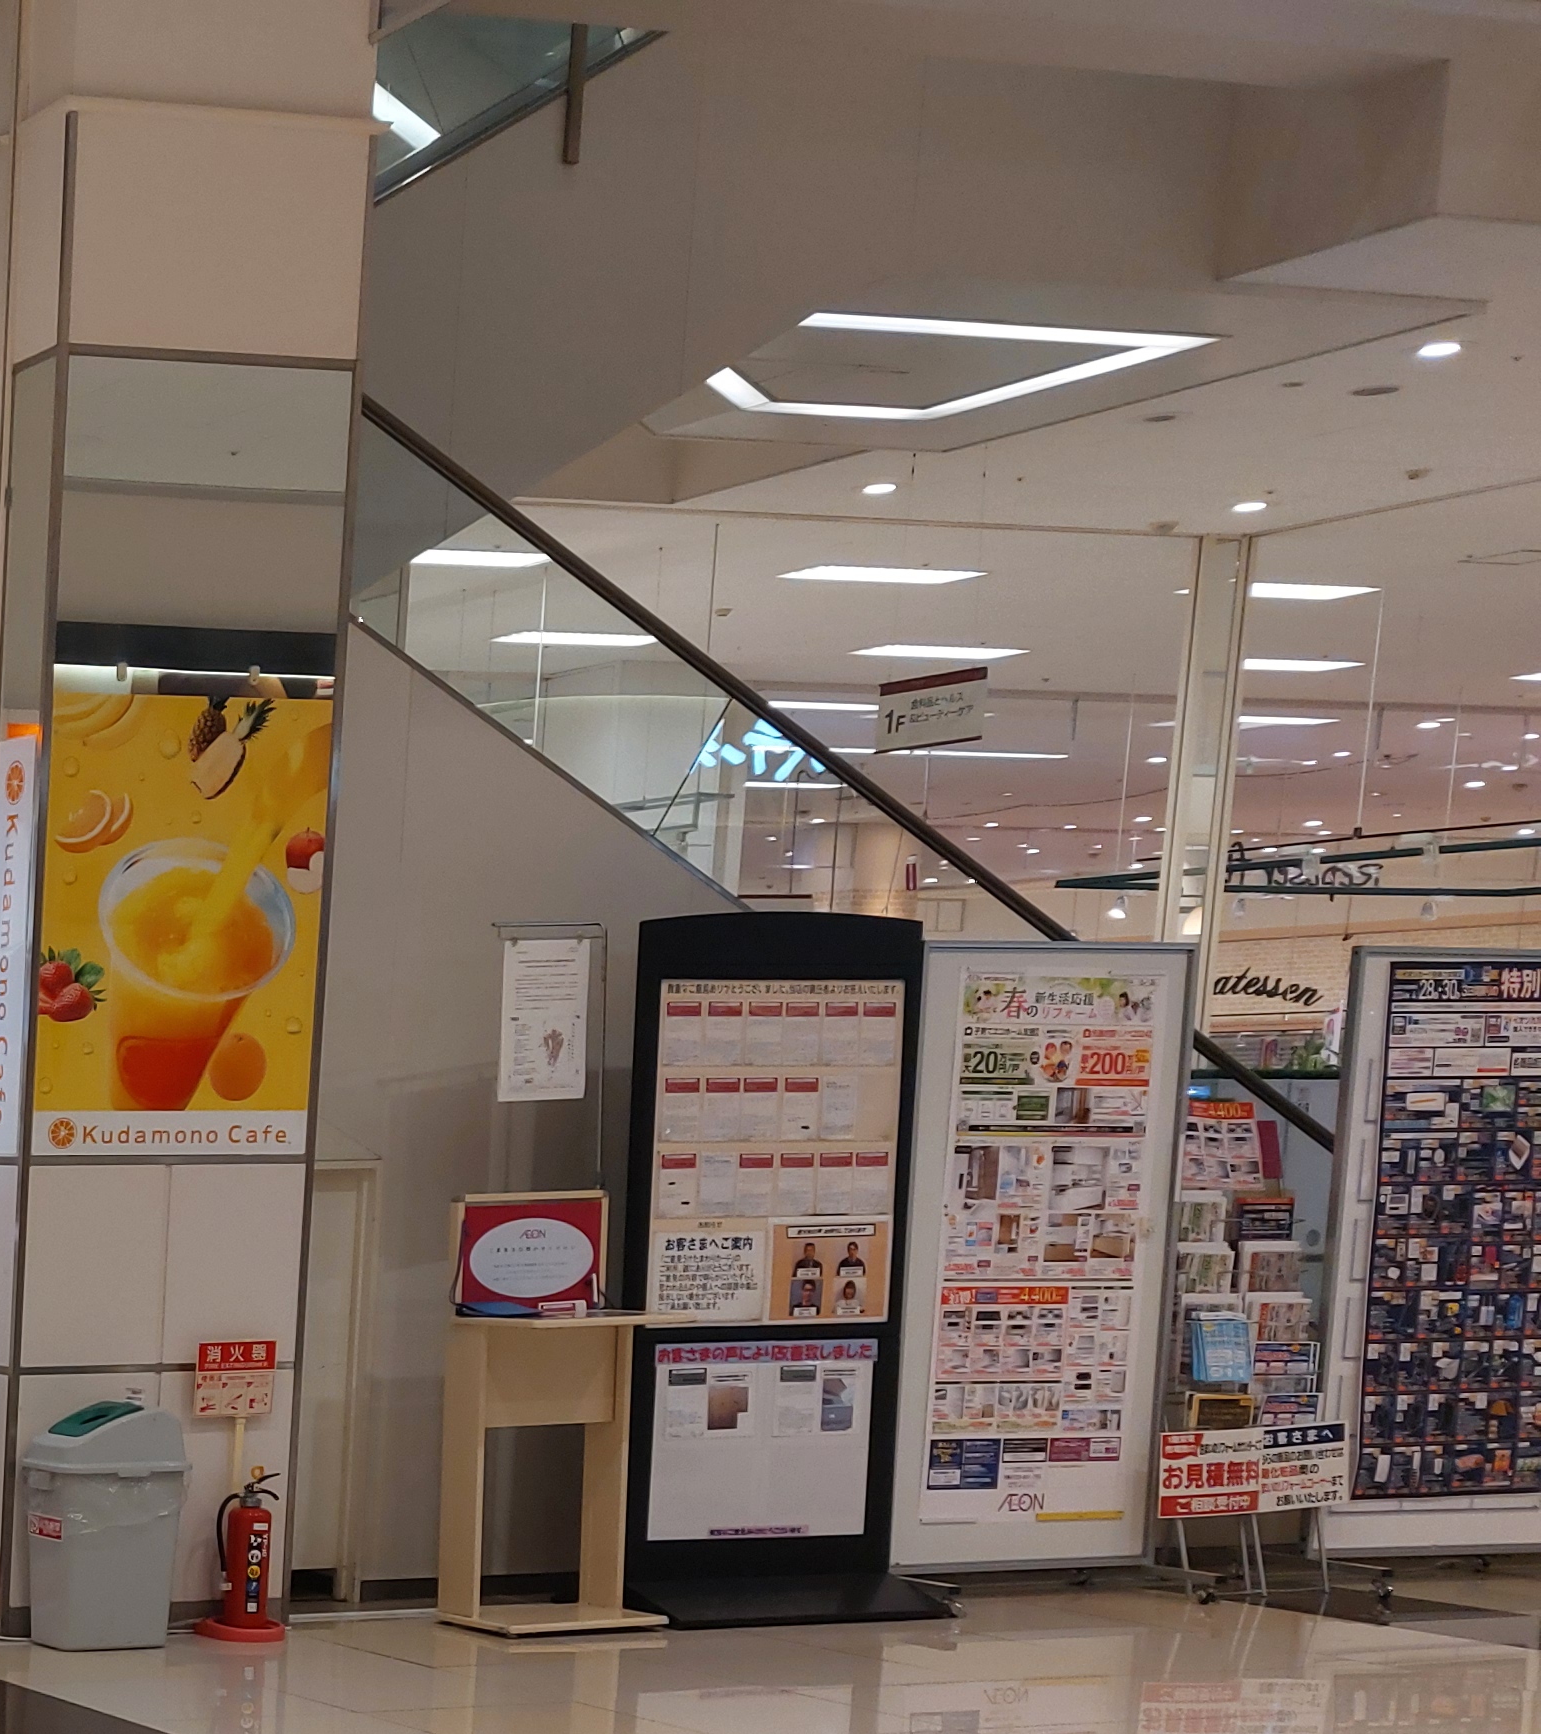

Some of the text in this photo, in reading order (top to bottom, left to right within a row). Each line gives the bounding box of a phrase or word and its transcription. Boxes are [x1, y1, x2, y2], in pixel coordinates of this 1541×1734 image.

[884, 709, 907, 734] 1F
[972, 1050, 998, 1074] 20
[1089, 1051, 1126, 1075] 200
[82, 1124, 288, 1145] Kudamono Cafe
[206, 1343, 267, 1363] 消火器
